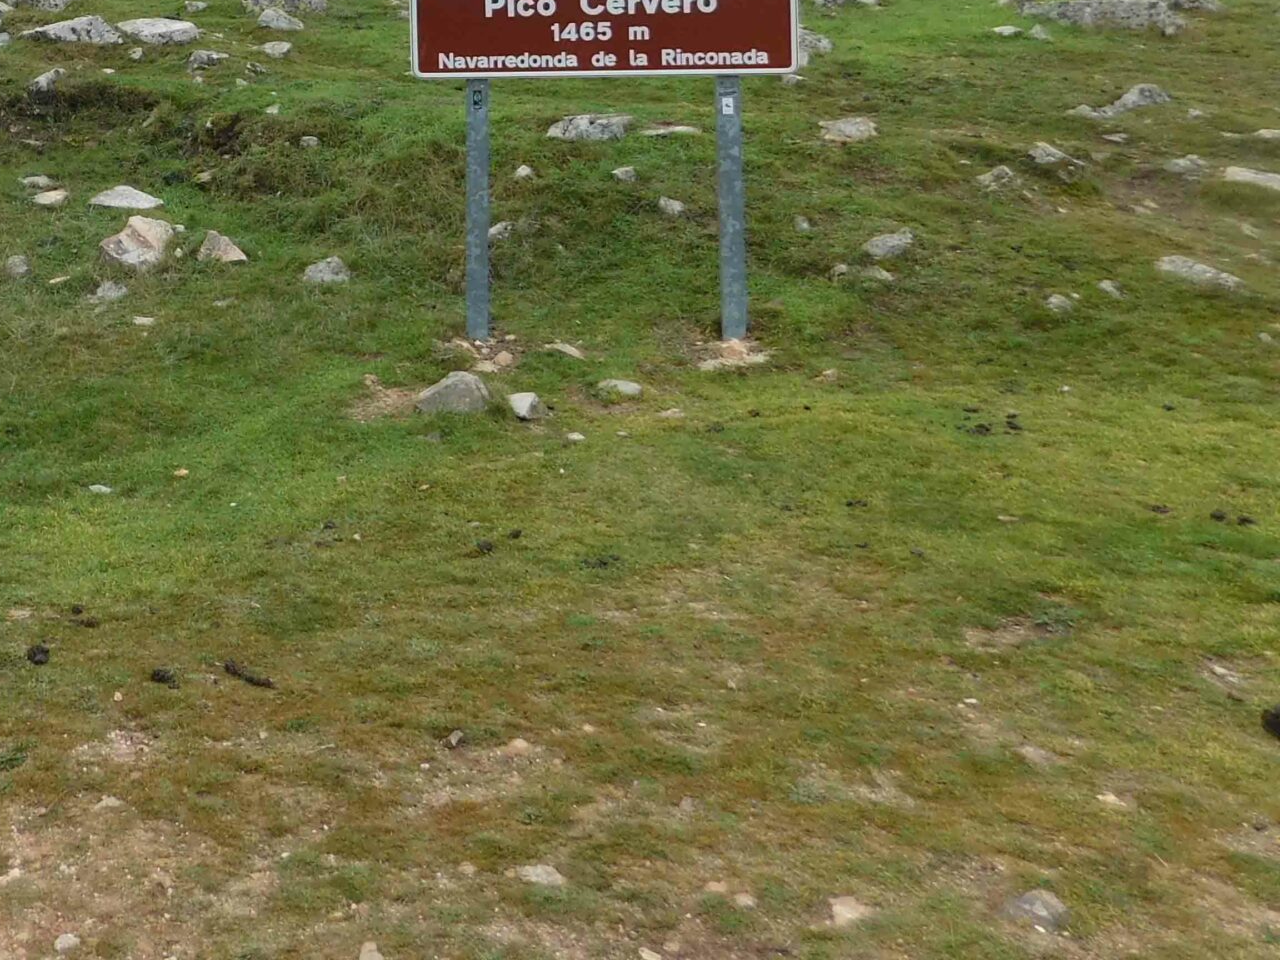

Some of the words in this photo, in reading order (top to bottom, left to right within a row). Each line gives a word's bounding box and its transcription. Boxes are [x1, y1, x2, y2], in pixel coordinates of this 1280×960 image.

[550, 22, 613, 42] 1465
[628, 25, 650, 41] m
[438, 51, 578, 70] Navarredonda
[591, 50, 617, 68] de
[628, 49, 649, 67] la
[661, 48, 769, 66] Rinconada
